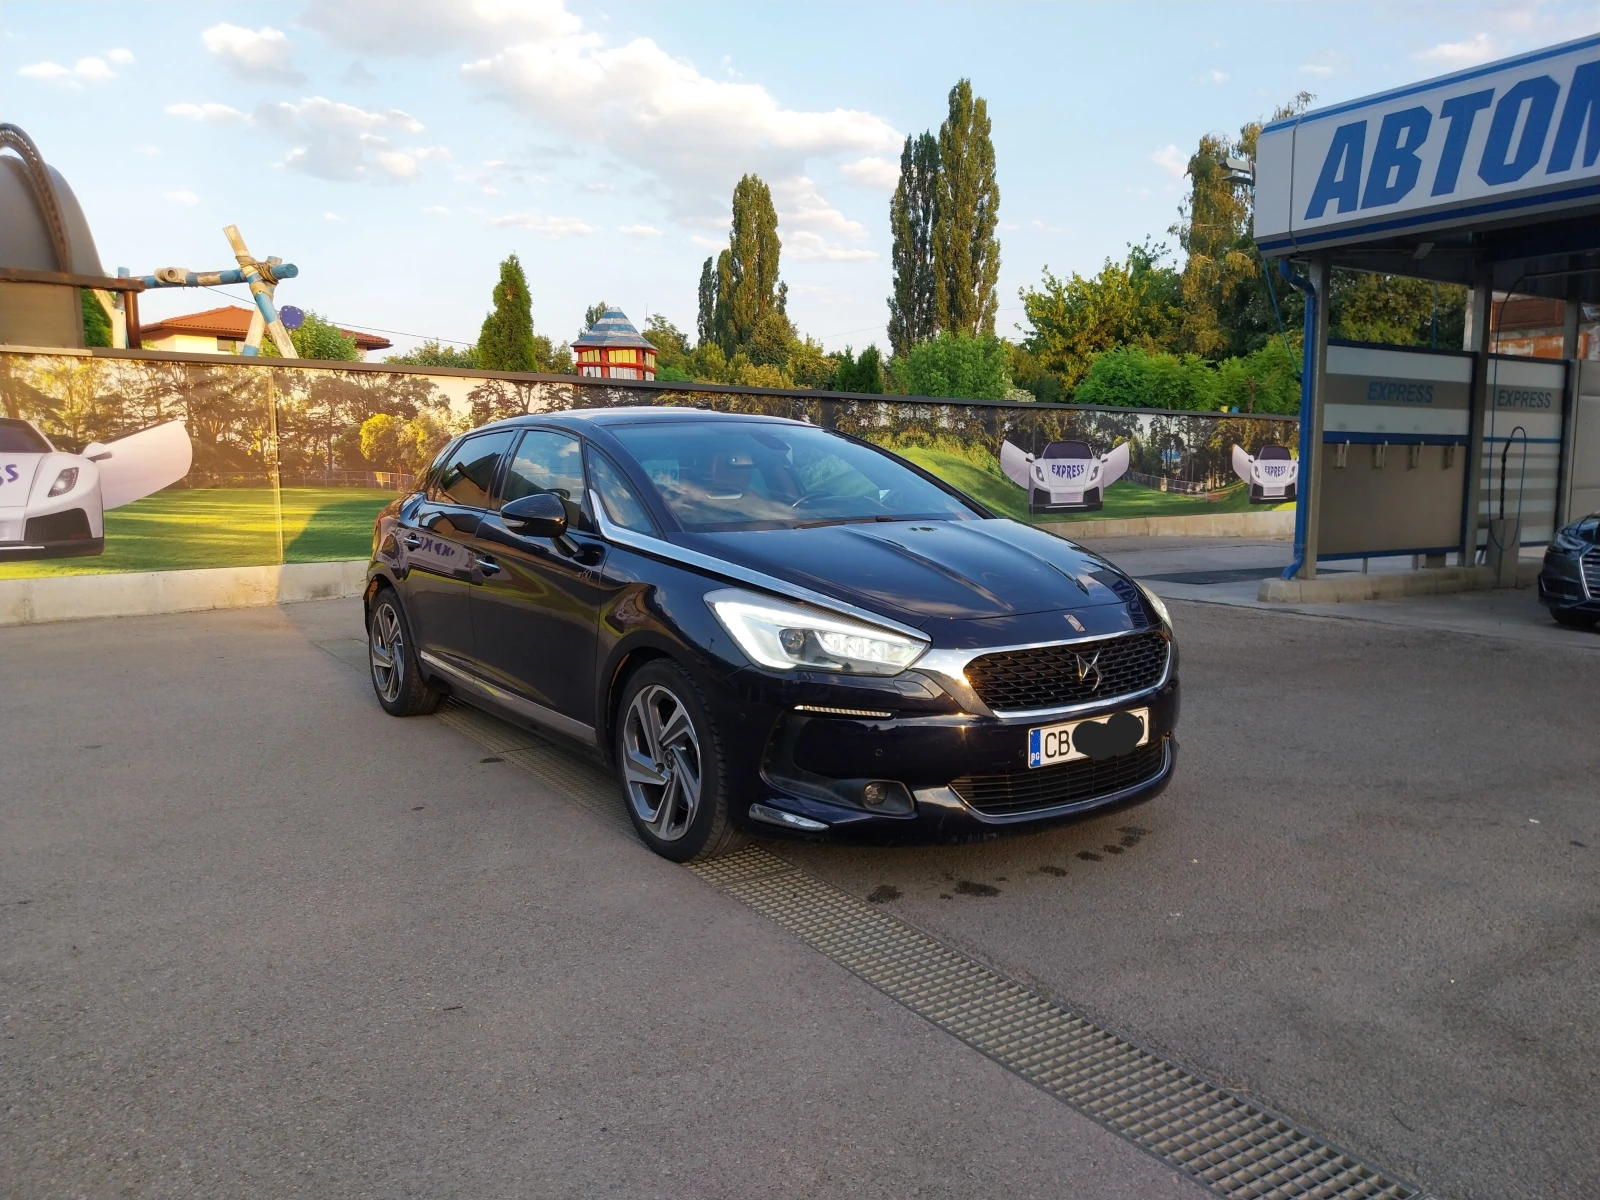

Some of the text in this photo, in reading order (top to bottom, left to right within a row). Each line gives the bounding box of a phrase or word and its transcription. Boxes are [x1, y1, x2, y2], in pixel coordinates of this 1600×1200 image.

[1367, 382, 1434, 403] EXPRESS
[1497, 389, 1552, 409] EXPRESS
[1051, 464, 1085, 480] EXPRESS
[1264, 465, 1286, 478] EXPRESS
